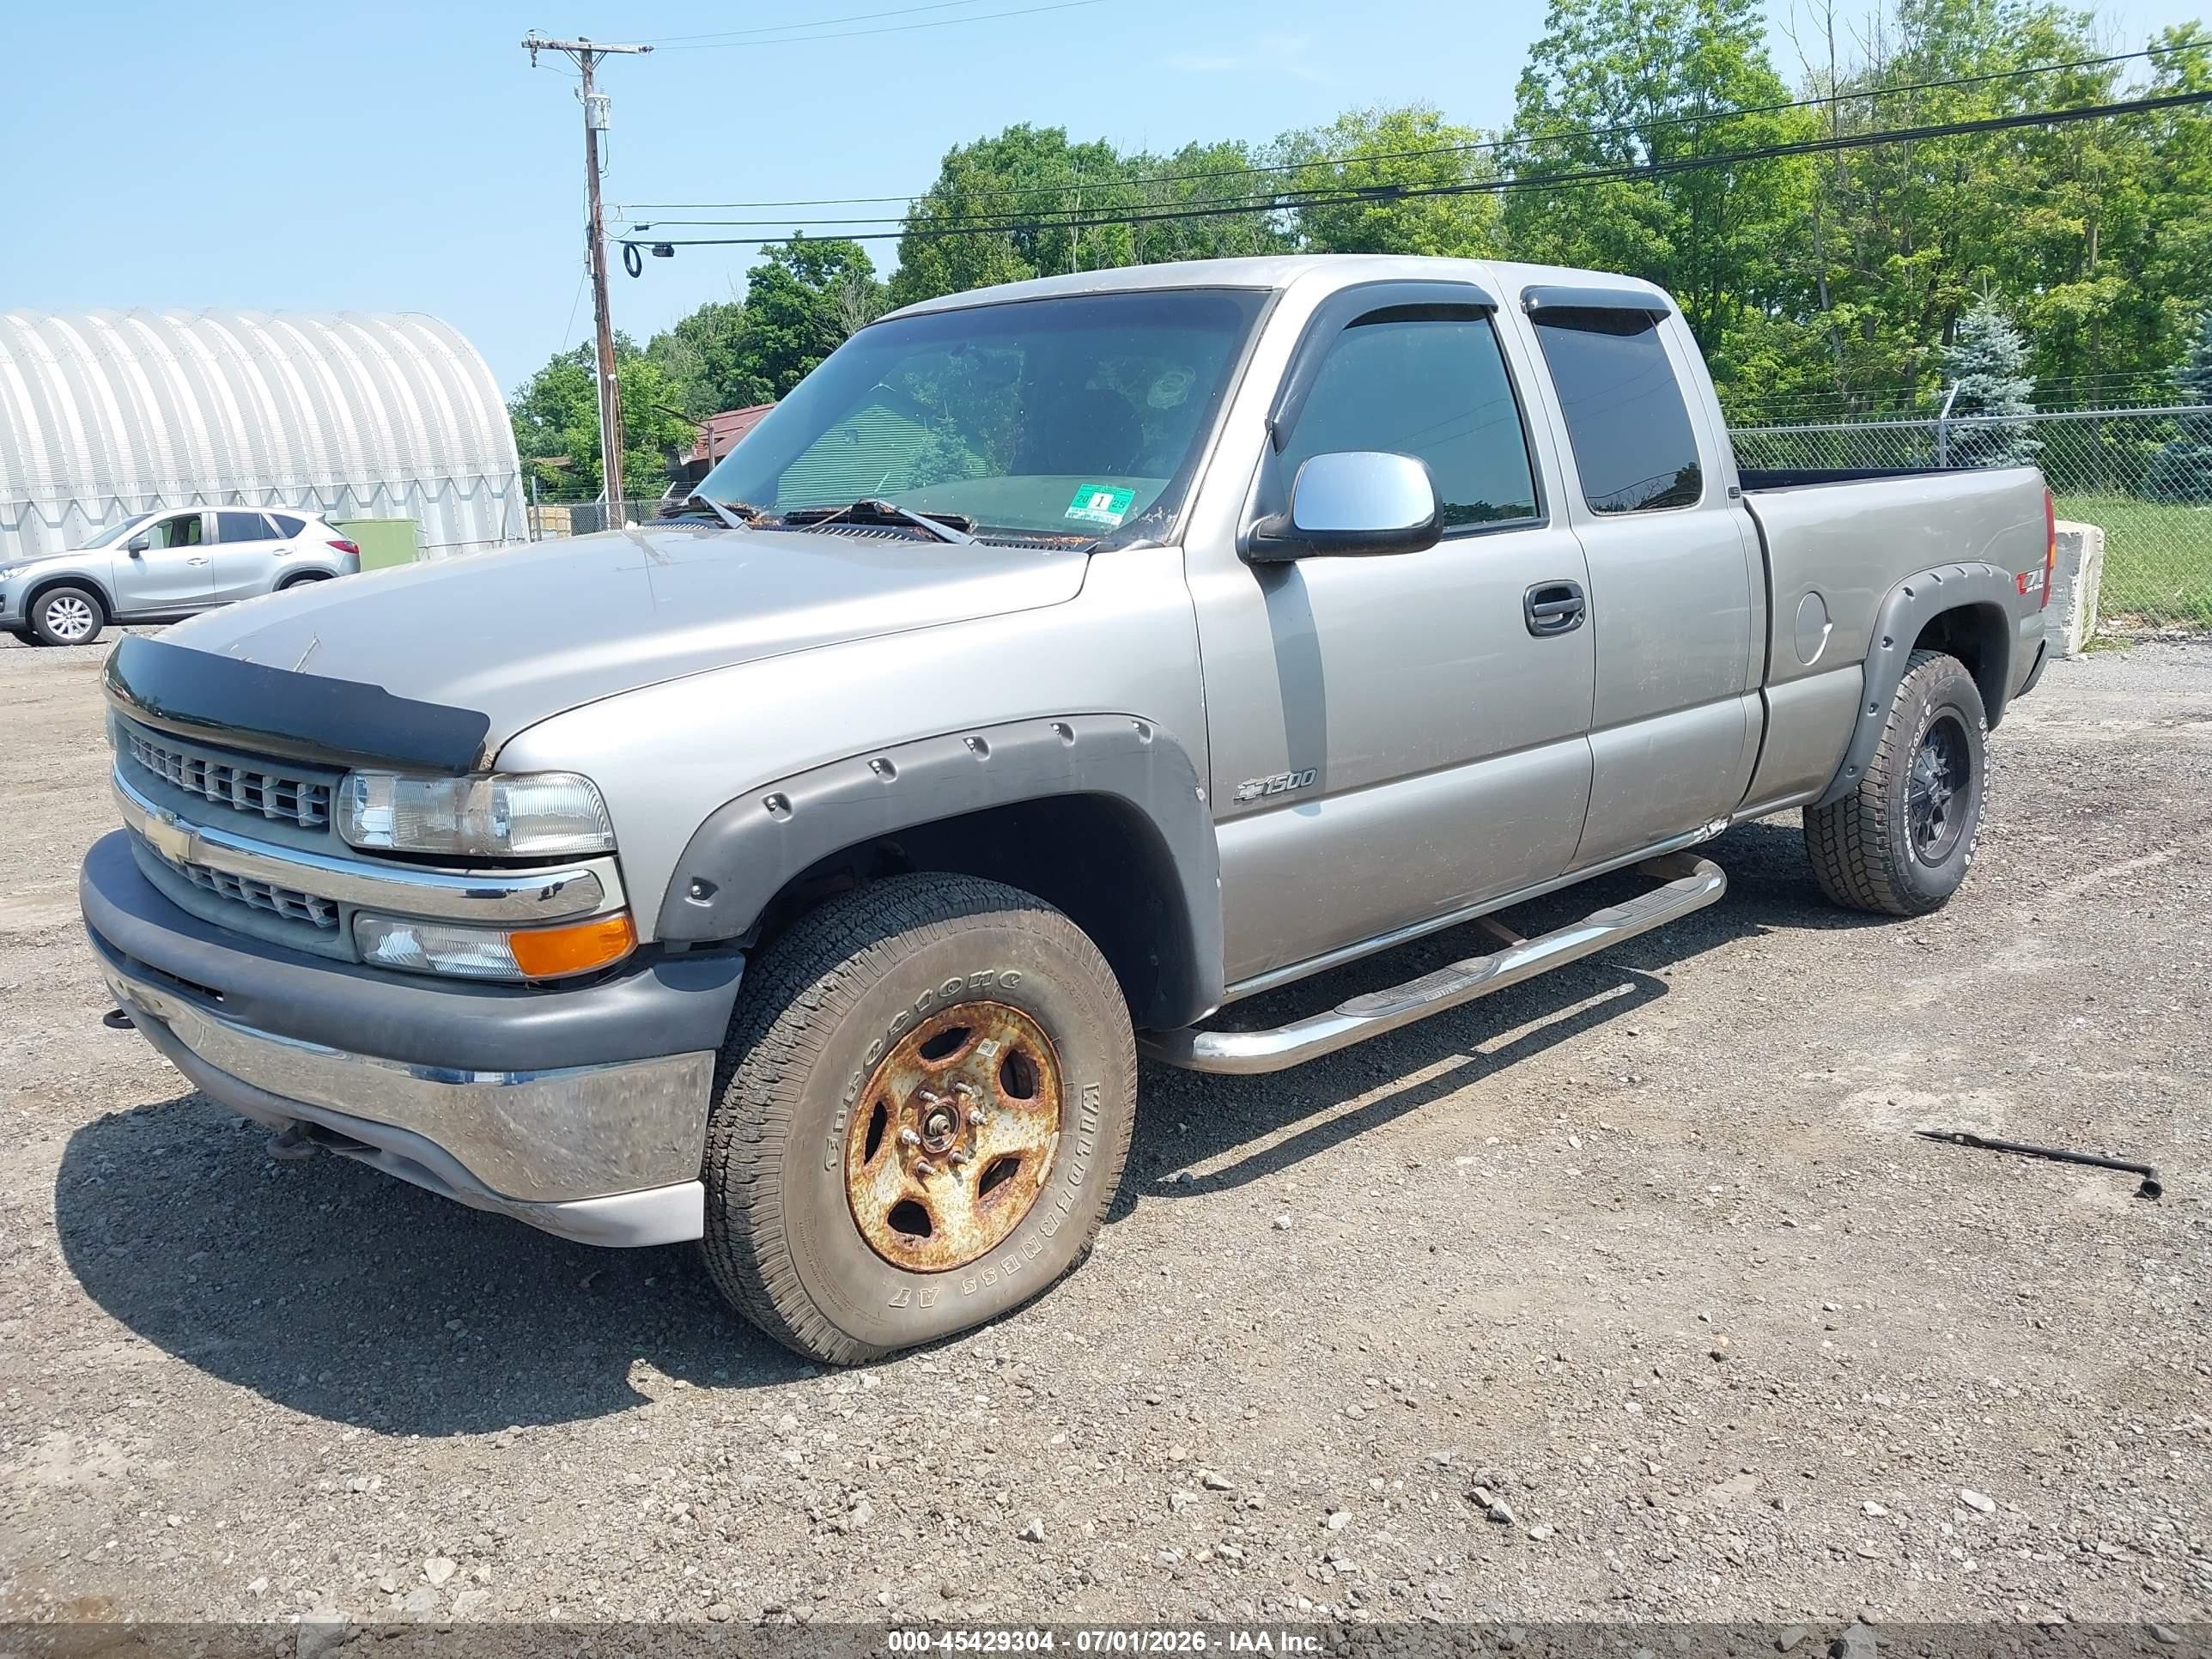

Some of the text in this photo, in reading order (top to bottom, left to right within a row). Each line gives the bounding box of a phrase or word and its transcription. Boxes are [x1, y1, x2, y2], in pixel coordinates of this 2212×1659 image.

[1076, 495, 1127, 509] 20 1 25
[1262, 769, 1317, 796] 1500
[960, 1081, 1100, 1296] WILDERNESS
[889, 1286, 940, 1309] AT
